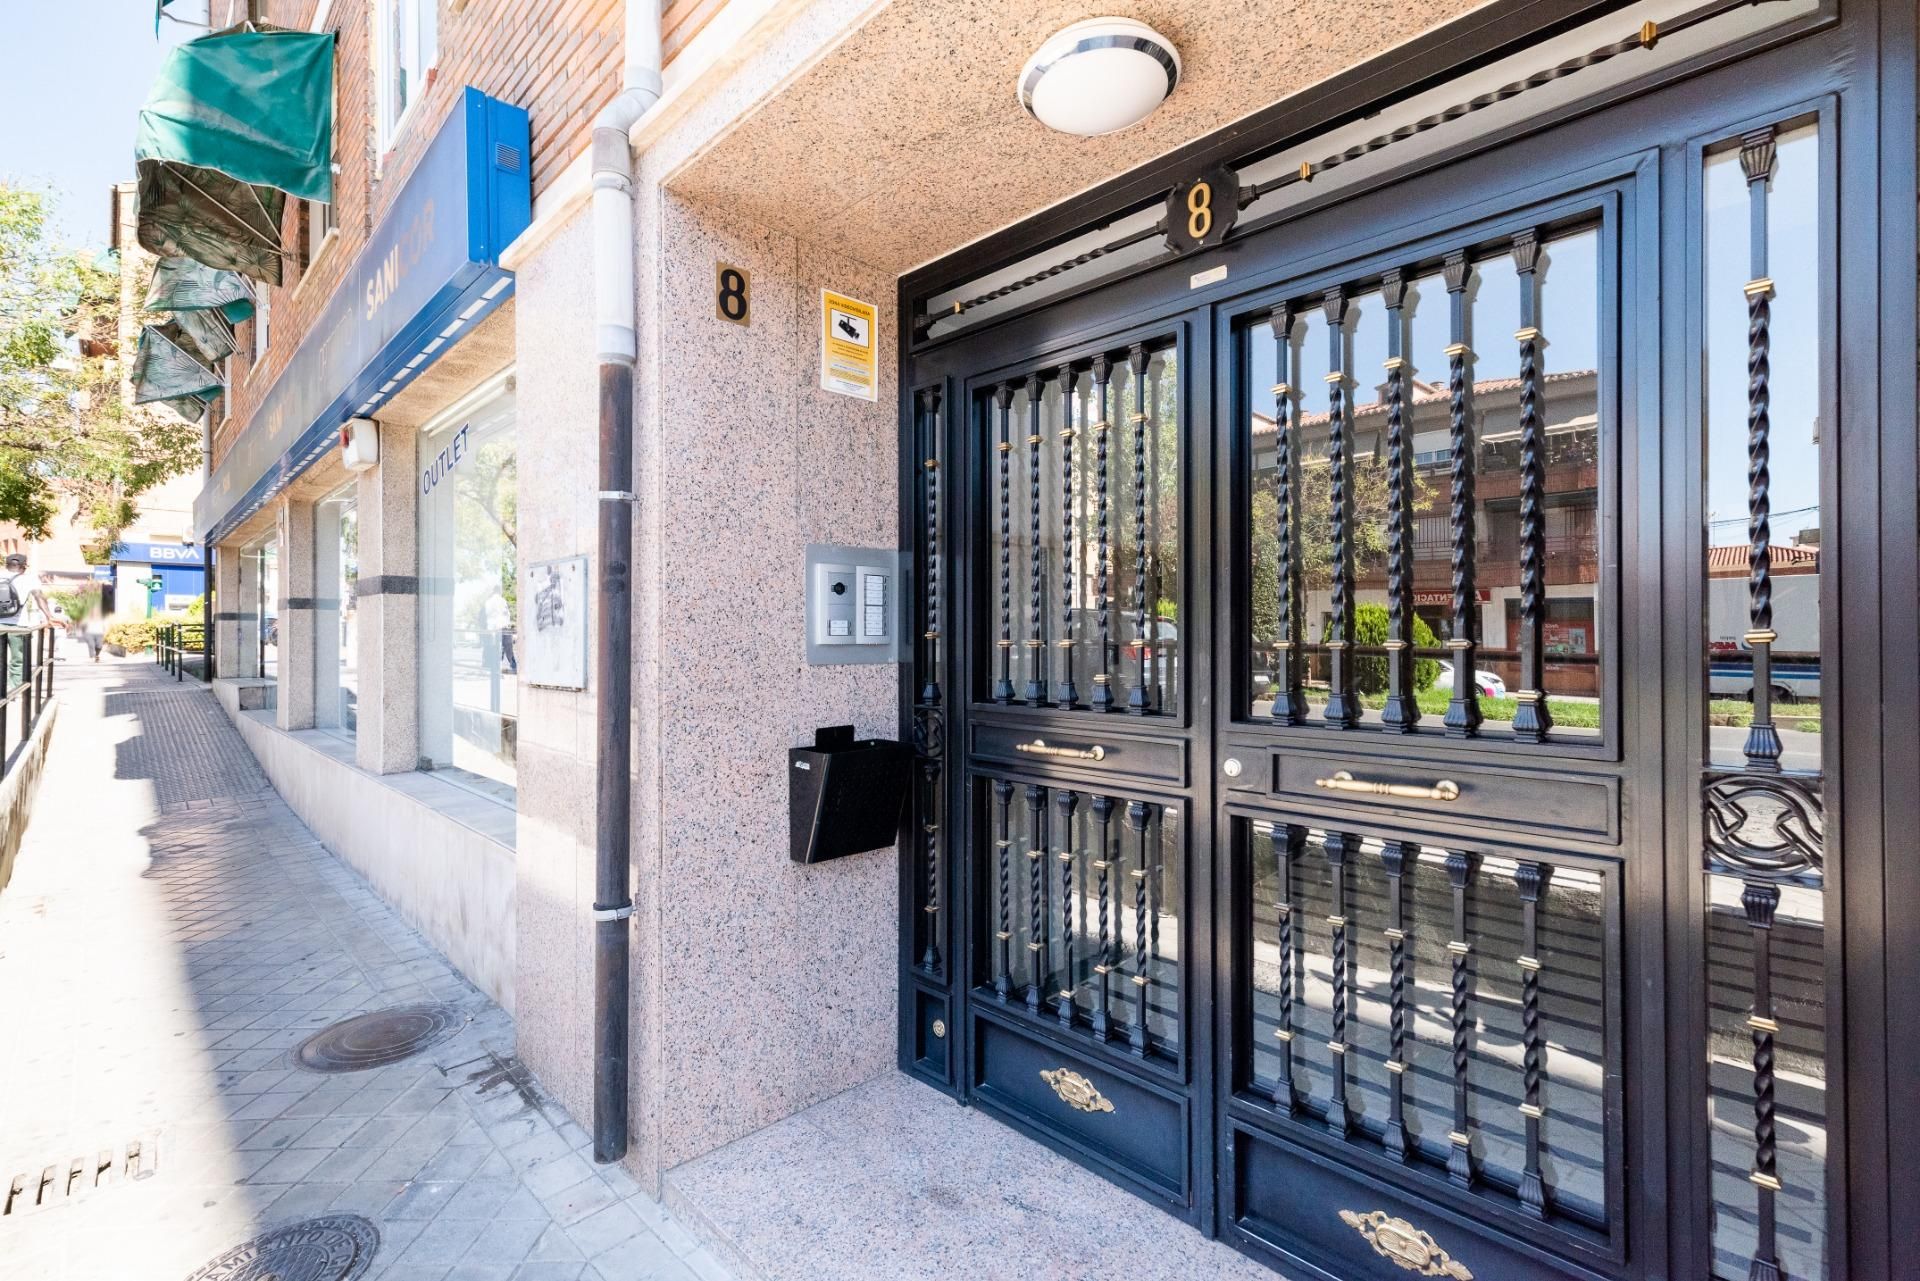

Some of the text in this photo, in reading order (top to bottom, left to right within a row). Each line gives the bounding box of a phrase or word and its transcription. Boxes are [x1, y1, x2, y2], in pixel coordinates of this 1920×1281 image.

[1187, 182, 1212, 238] 8
[718, 268, 747, 321] 8
[423, 423, 469, 495] OUTLET
[149, 546, 200, 560] BBVA
